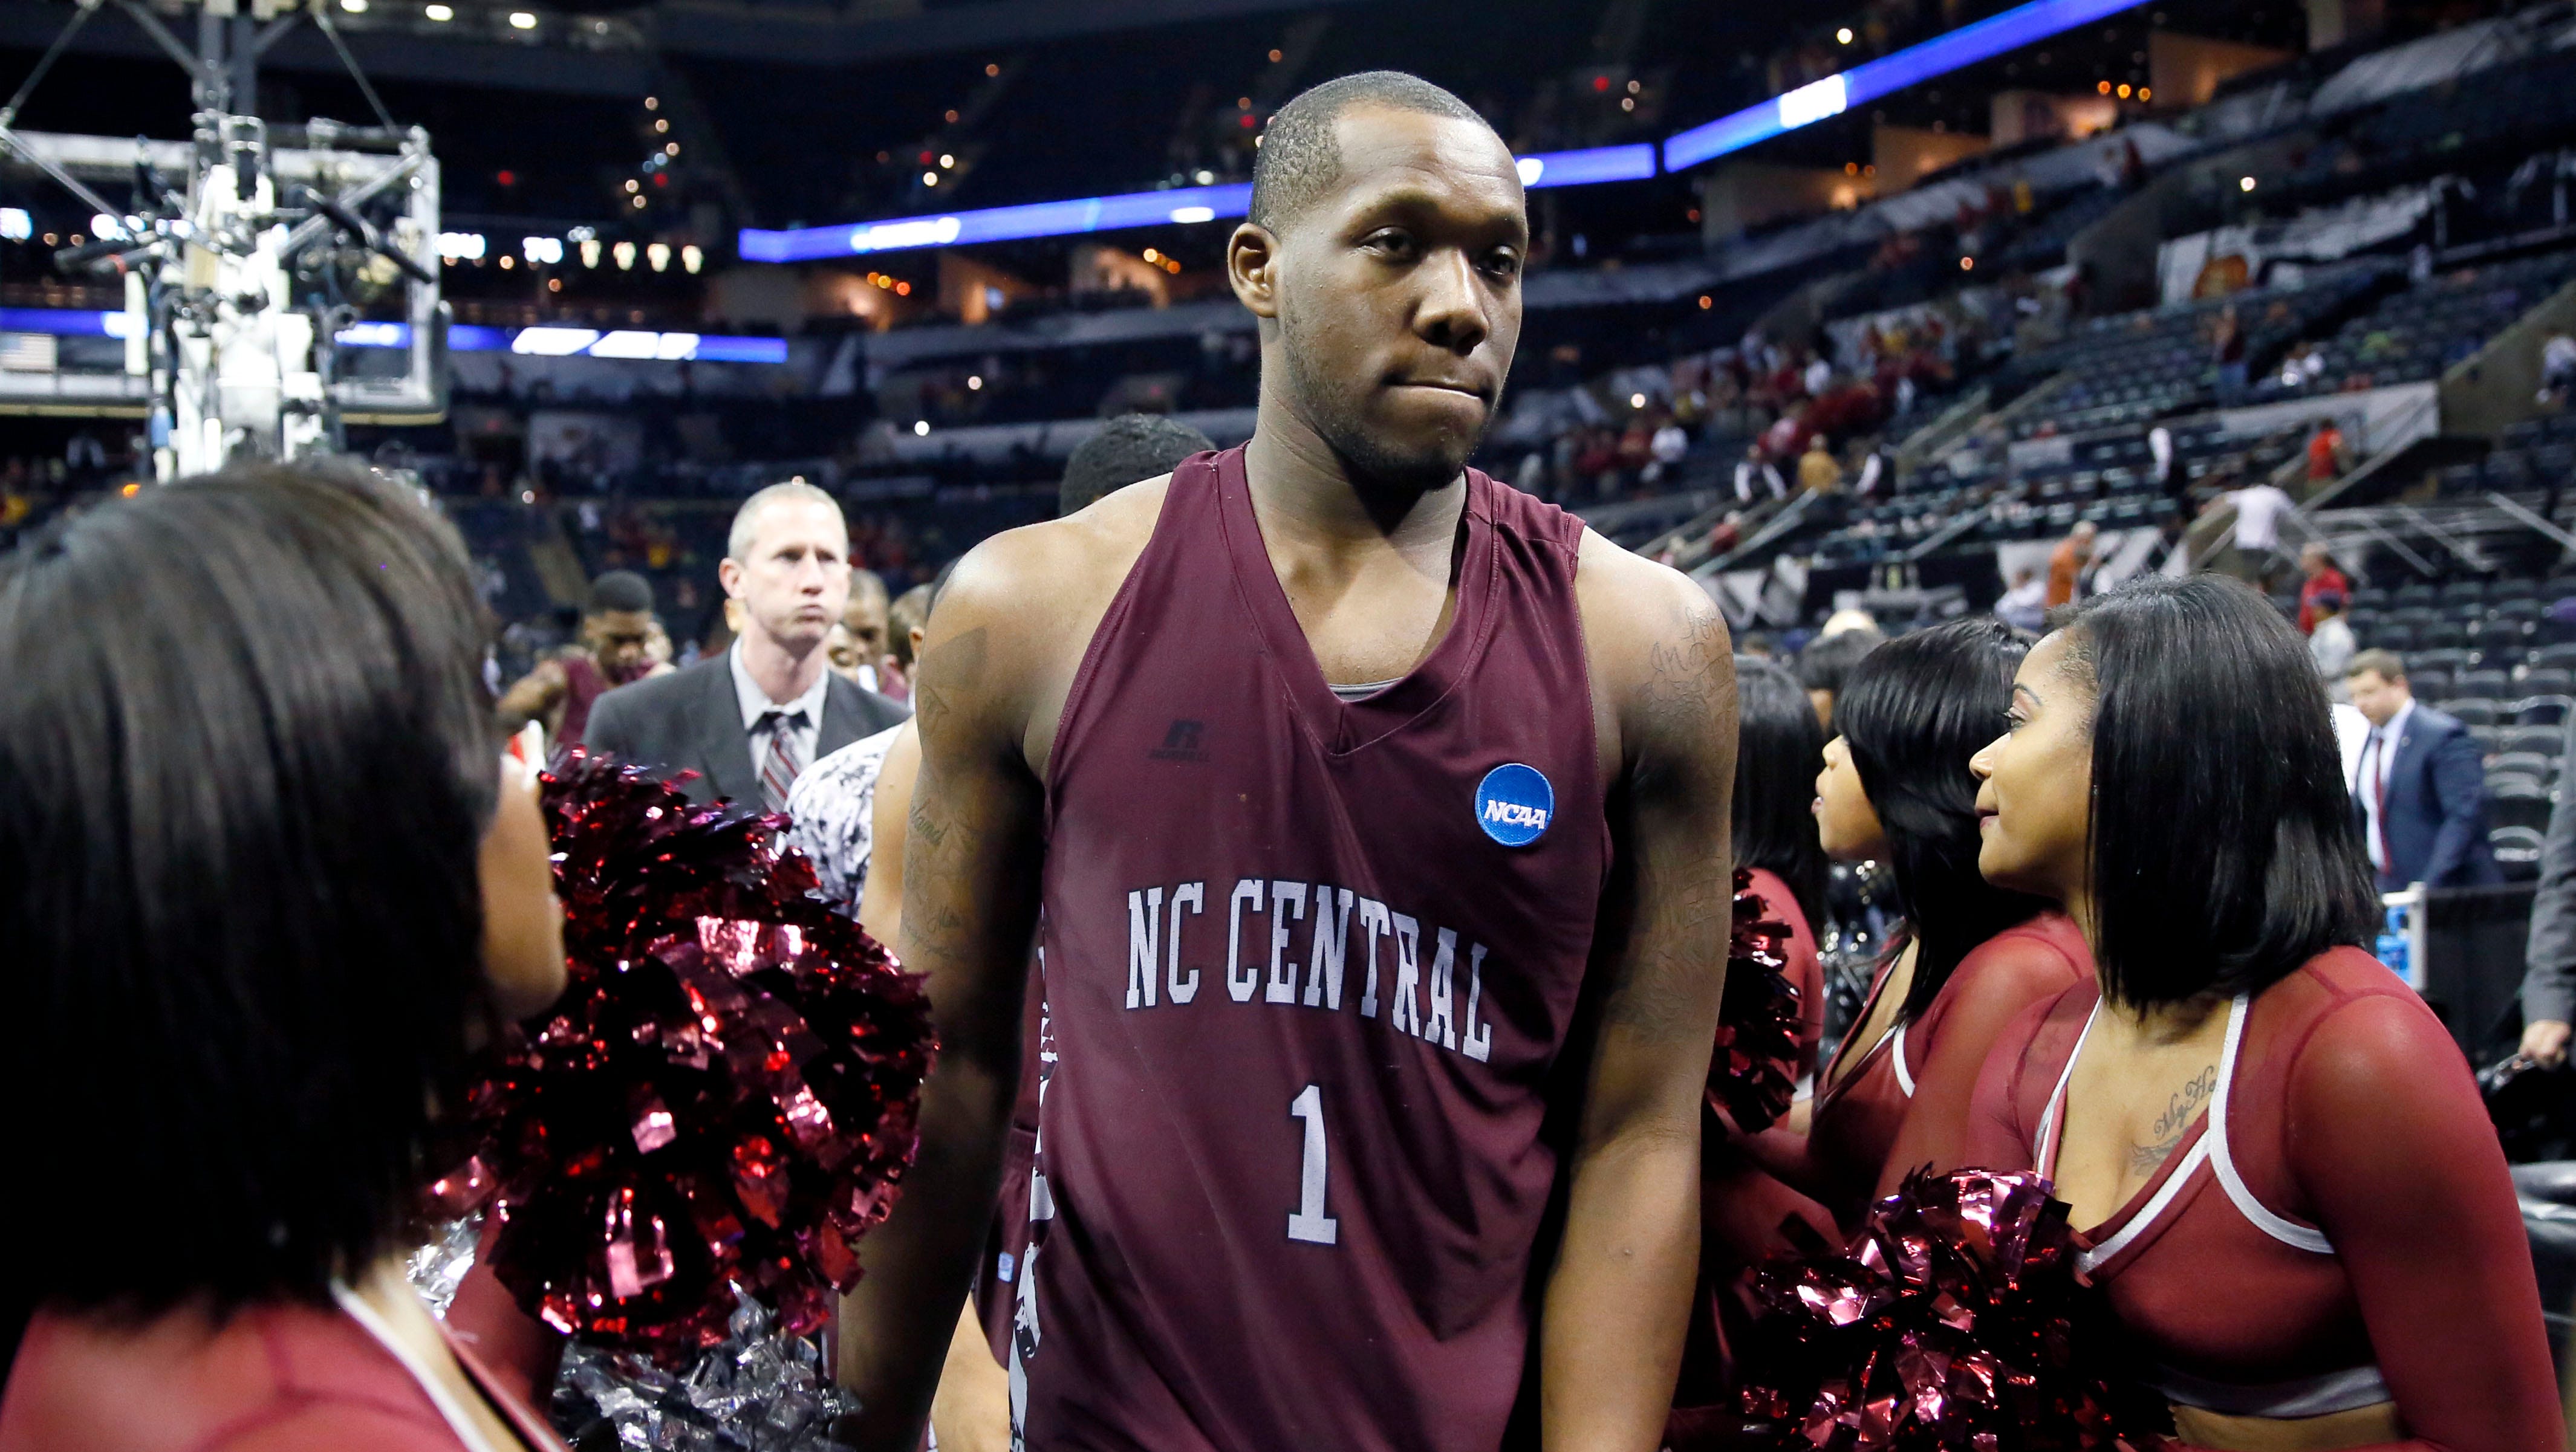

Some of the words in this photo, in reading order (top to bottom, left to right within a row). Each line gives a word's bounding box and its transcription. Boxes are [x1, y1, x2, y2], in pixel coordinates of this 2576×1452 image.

[1484, 799, 1547, 829] NCAA
[1126, 881, 1203, 1010] NC
[1226, 878, 1492, 1063] CENTRAL
[1287, 1084, 1337, 1245] 1
